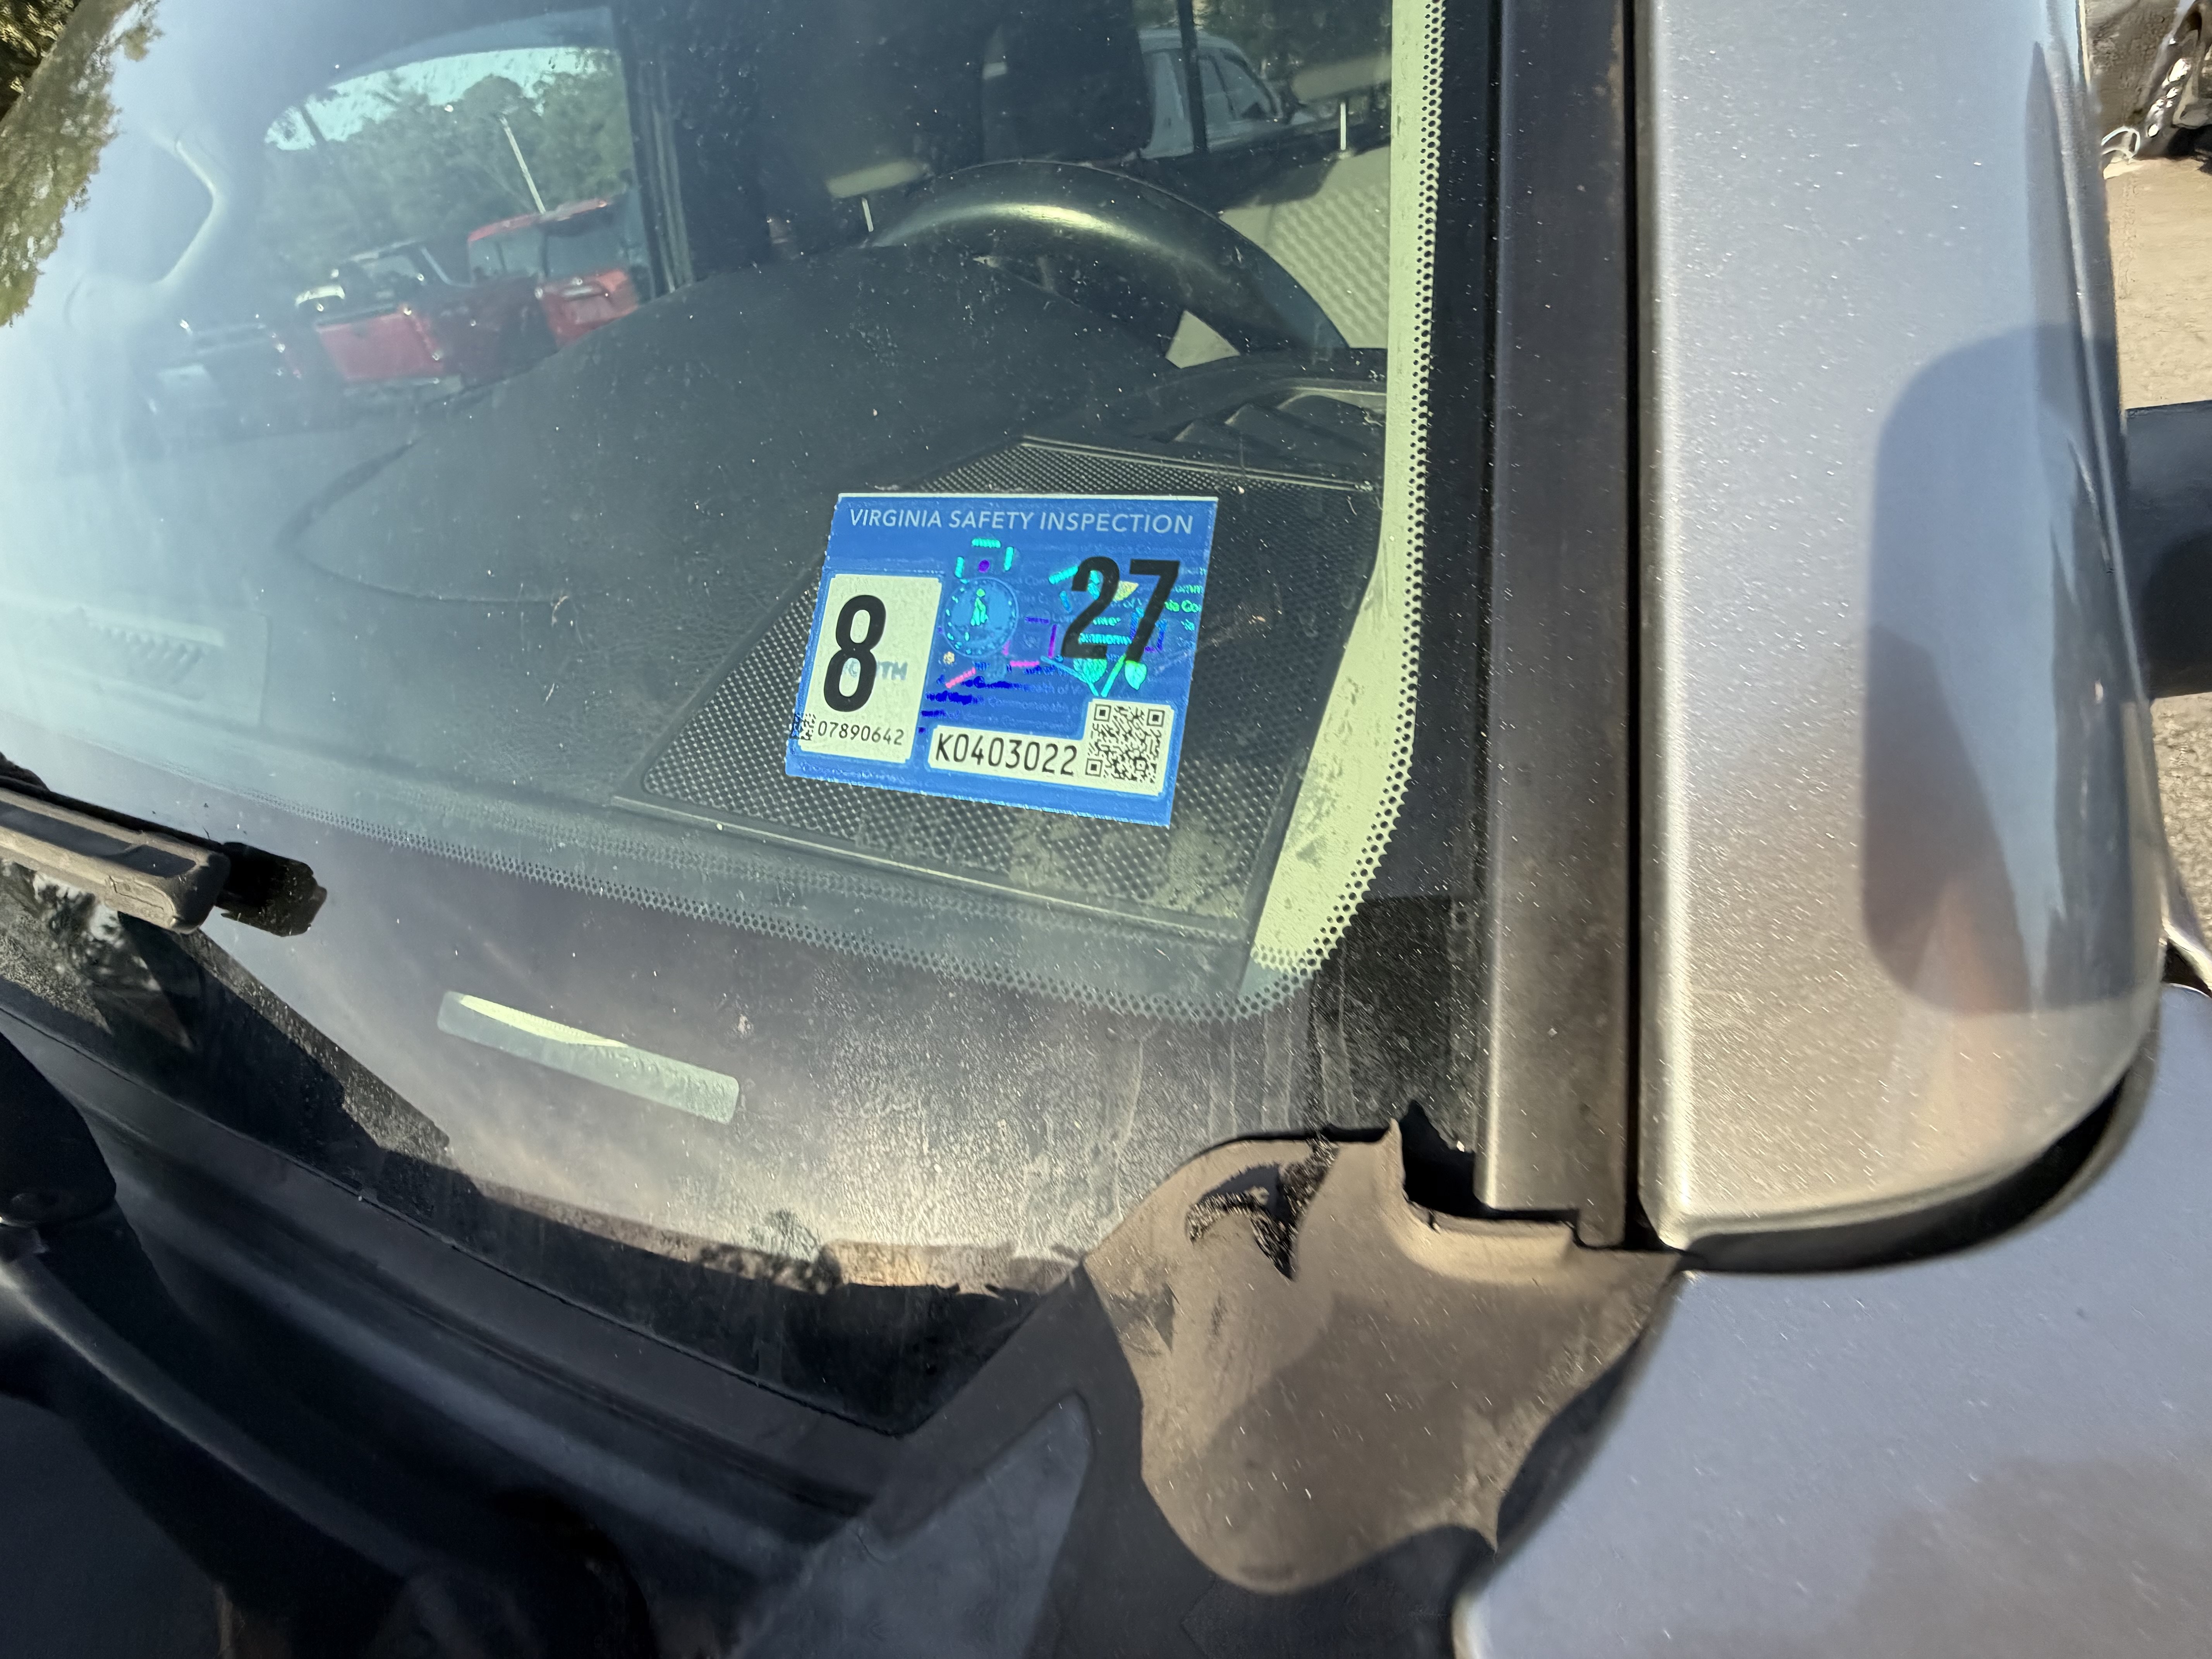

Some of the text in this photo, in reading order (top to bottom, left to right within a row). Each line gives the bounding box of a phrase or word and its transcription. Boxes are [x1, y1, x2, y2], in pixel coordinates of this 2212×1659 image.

[850, 508, 1194, 534] VIRGINIA SAFETY INSPECTION
[1060, 555, 1181, 663] 27
[824, 594, 886, 713] 8
[817, 720, 904, 746] 07890642
